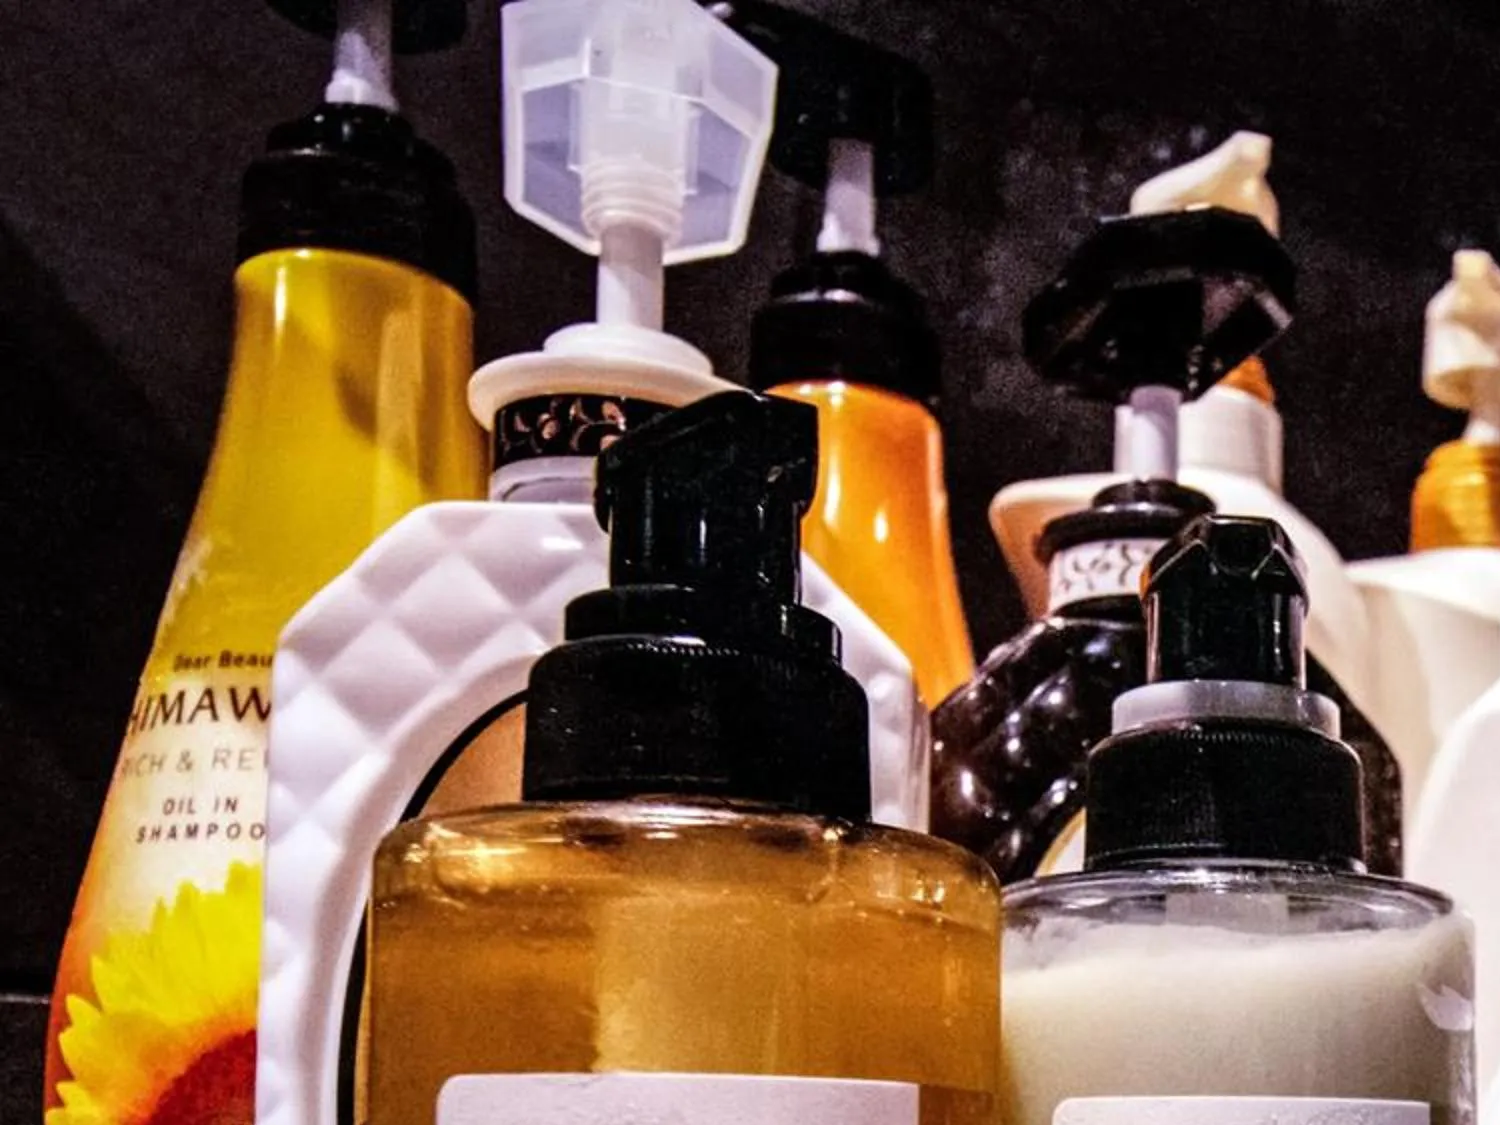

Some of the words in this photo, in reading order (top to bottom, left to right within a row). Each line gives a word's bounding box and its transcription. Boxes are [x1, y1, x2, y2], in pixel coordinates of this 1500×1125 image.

[176, 751, 194, 773] &
[162, 799, 197, 816] OIL
[213, 798, 238, 813] IN
[135, 823, 266, 844] SHAMPOO
